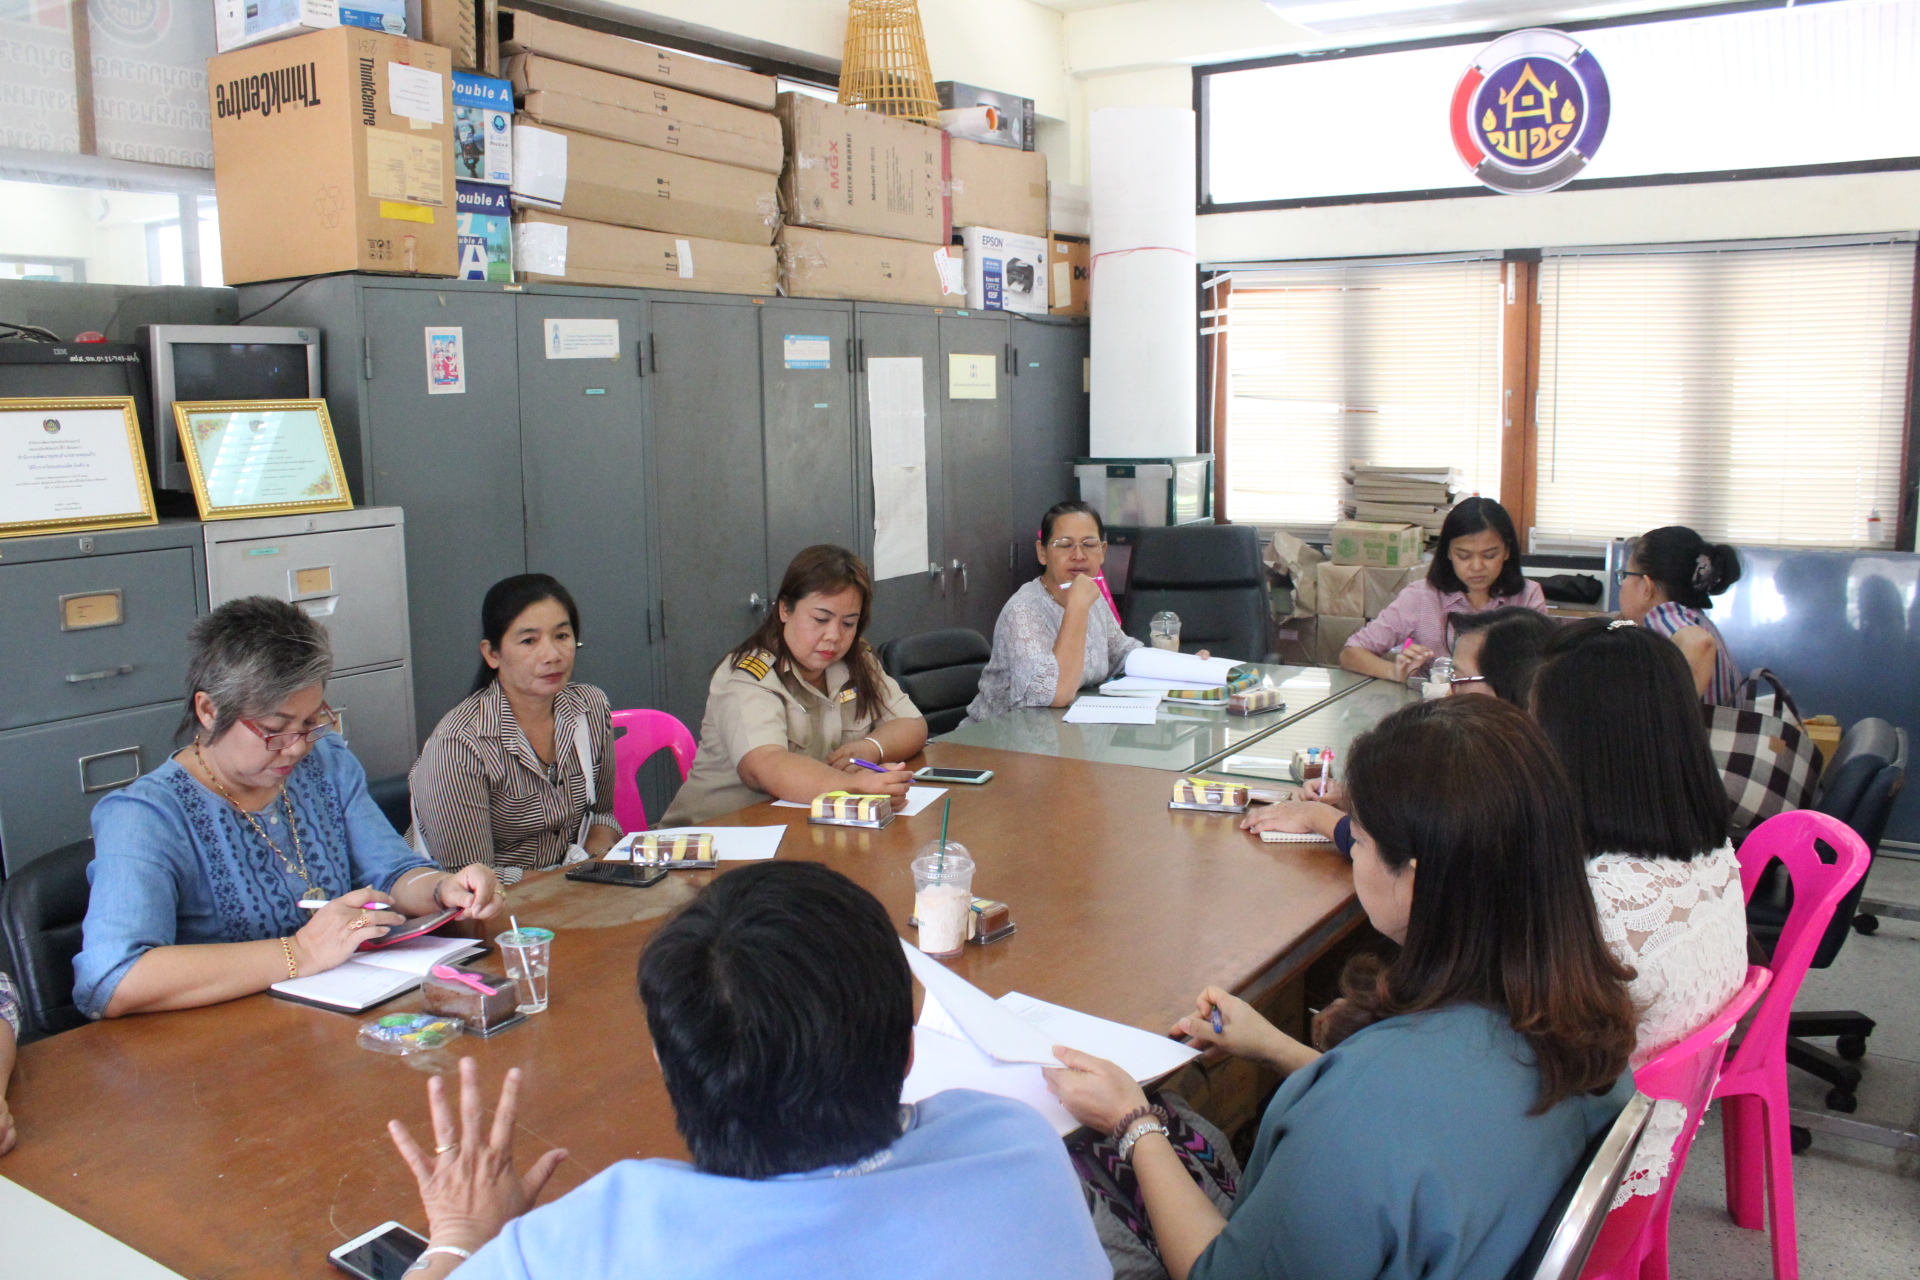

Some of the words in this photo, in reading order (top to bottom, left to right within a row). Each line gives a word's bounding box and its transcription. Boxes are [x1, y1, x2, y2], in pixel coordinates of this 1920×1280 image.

[216, 62, 321, 120] ThinkCentre
[359, 57, 377, 127] ThinkCentre
[500, 89, 508, 101] A
[829, 139, 840, 190] MGX
[496, 194, 506, 207] A
[982, 235, 1003, 248] EPSON
